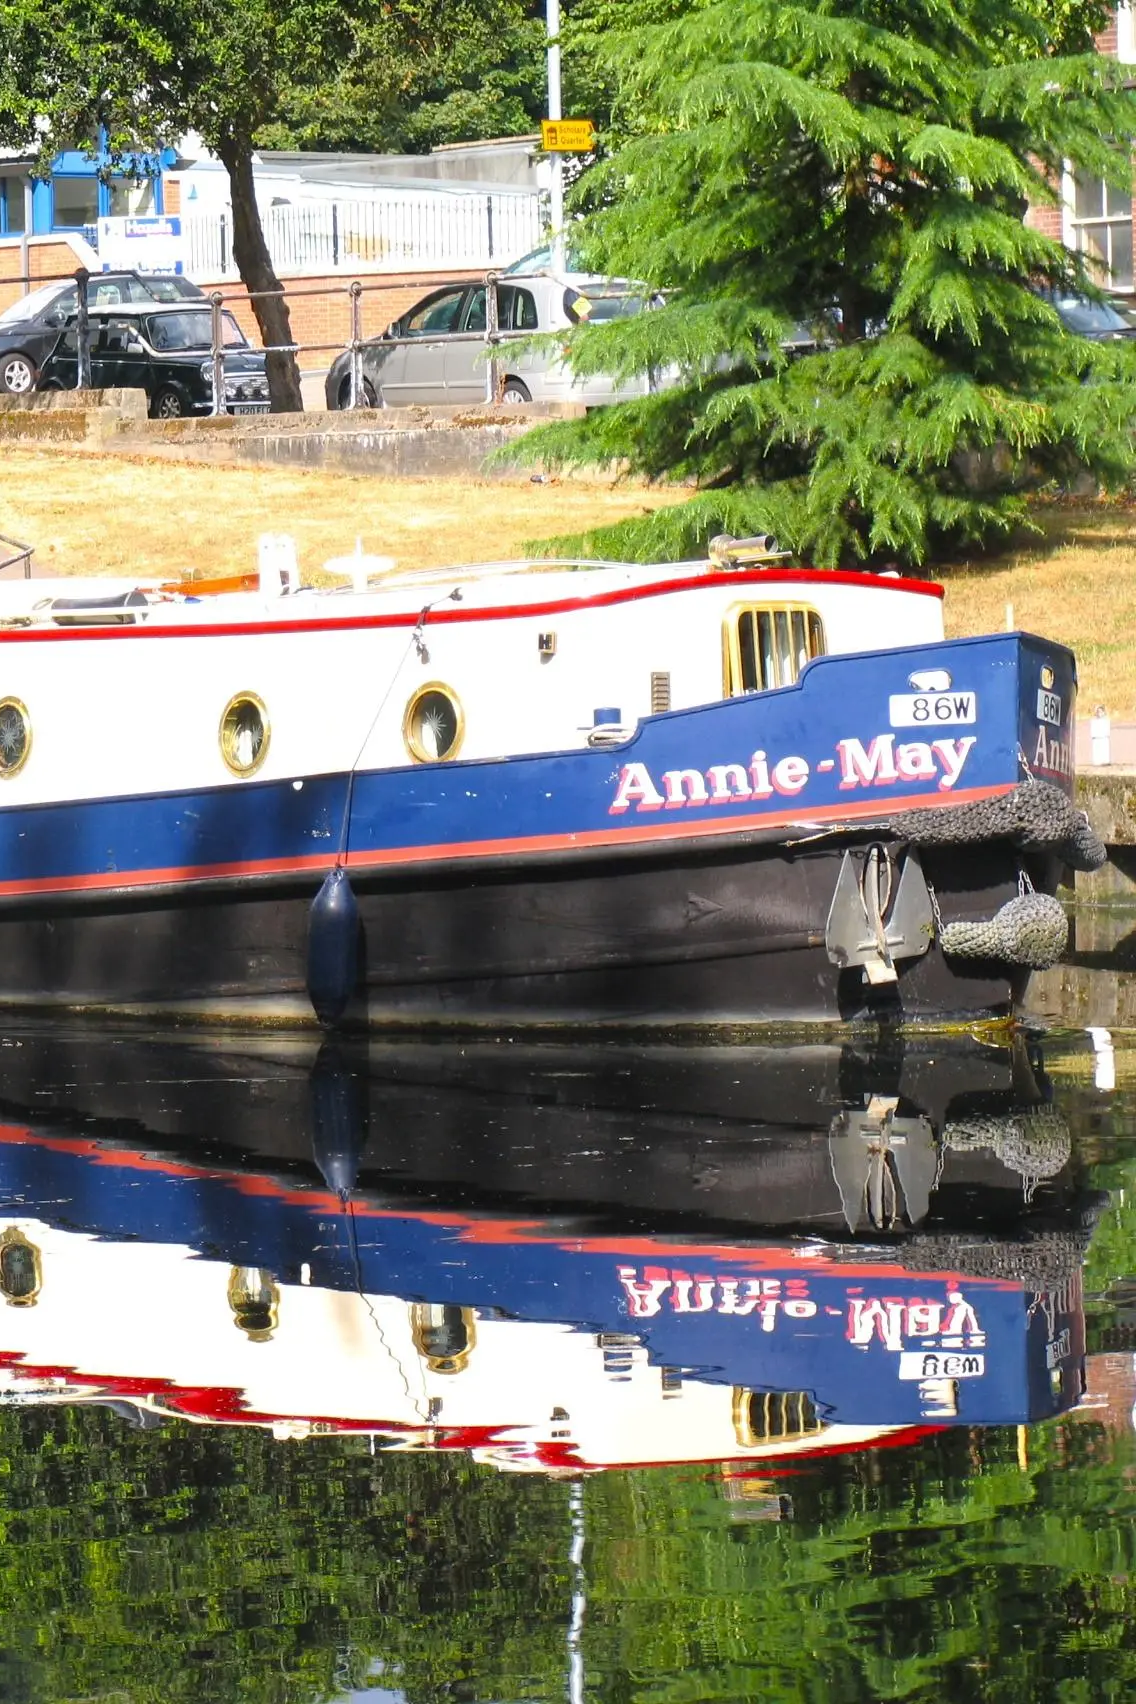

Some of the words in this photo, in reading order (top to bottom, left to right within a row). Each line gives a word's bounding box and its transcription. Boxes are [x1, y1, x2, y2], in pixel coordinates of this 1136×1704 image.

[561, 136, 585, 145] Quarter
[912, 696, 971, 721] 86W
[609, 734, 977, 814] Annie-May
